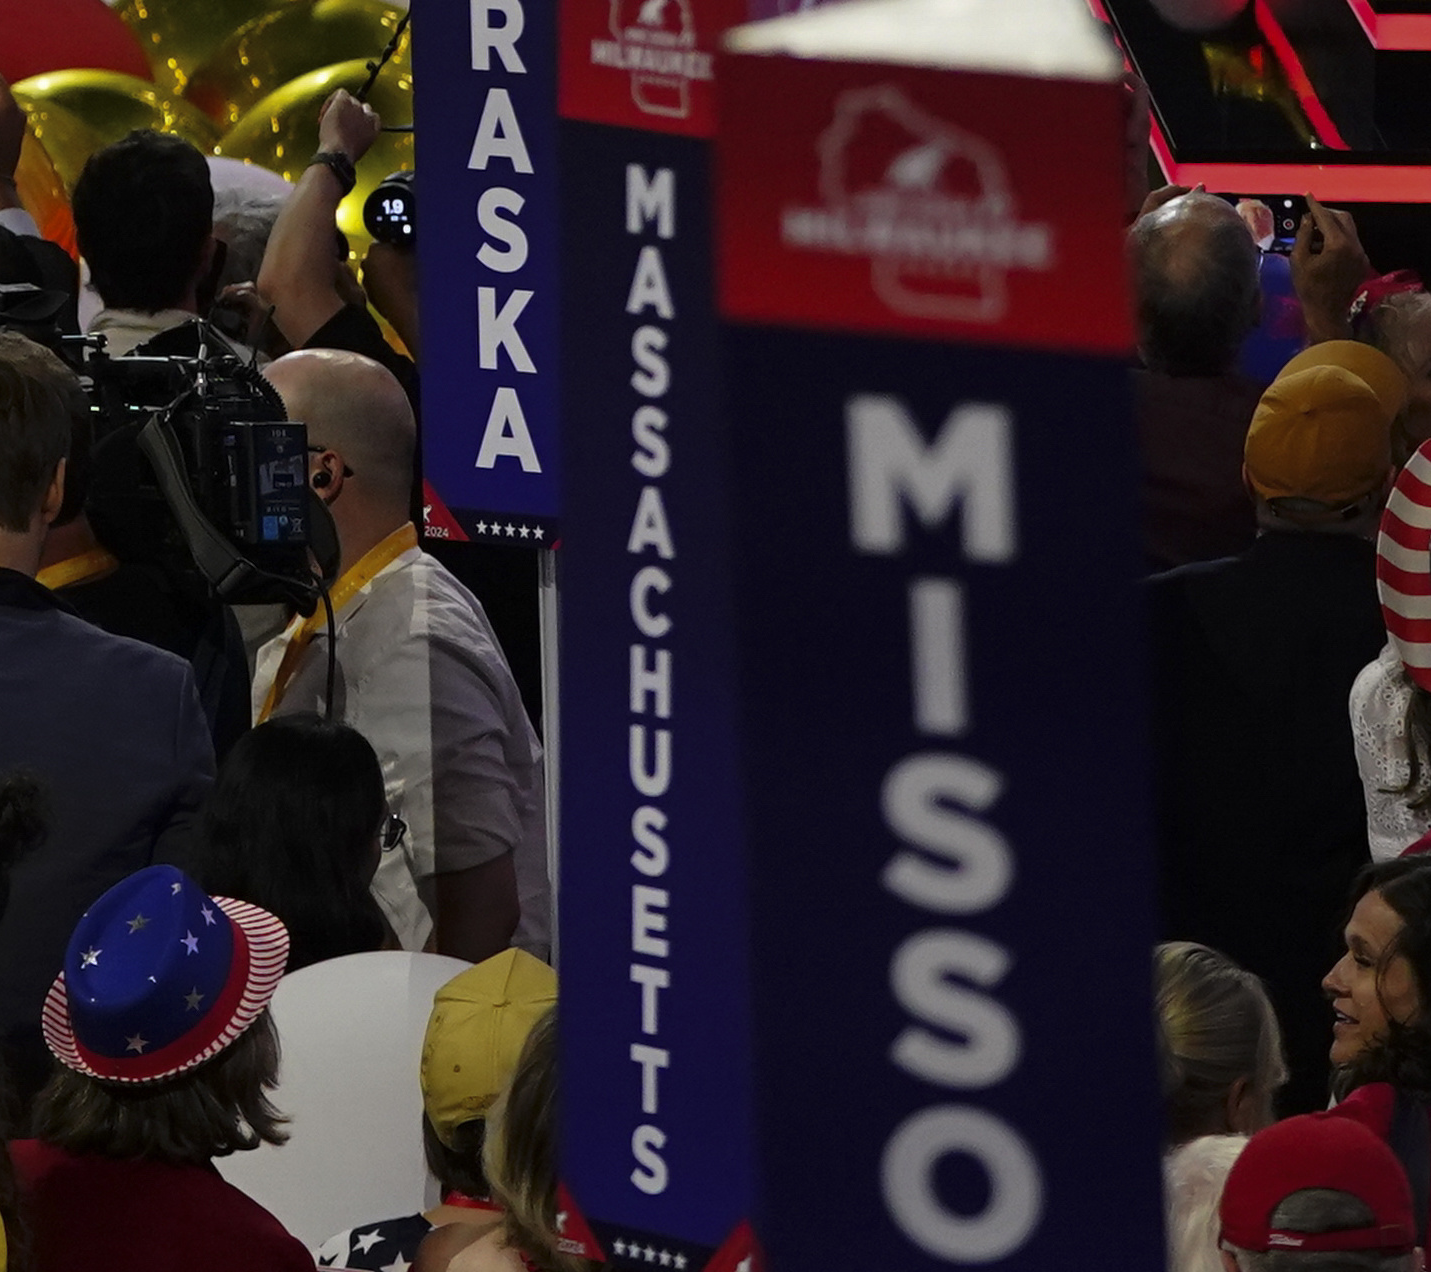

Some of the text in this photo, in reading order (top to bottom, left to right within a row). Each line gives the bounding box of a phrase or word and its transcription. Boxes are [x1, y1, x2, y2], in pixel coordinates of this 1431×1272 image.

[424, 525, 449, 537] 2024
[624, 163, 675, 1197] MASSACHUSETTS
[843, 393, 1044, 1262] MISSO
